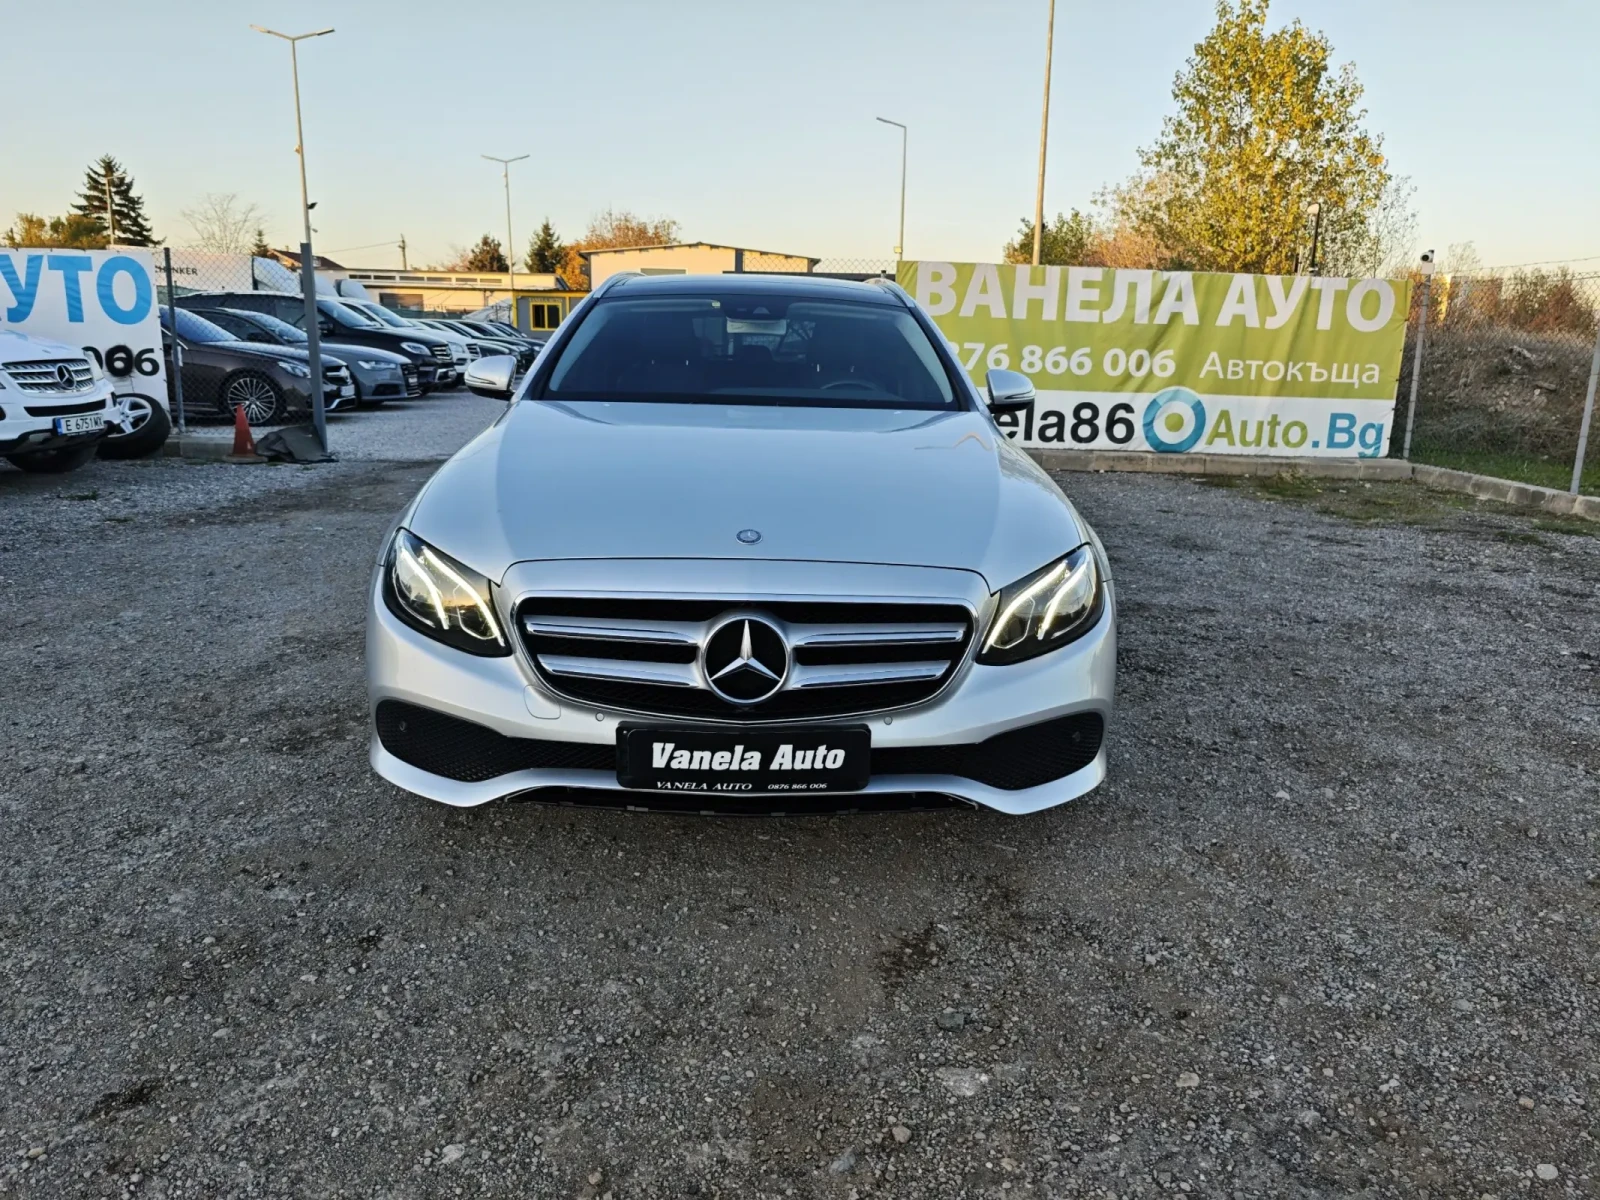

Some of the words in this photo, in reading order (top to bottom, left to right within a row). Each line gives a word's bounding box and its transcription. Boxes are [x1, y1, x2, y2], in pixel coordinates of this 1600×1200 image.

[914, 260, 1200, 326] ВАНЕЛА
[1215, 274, 1396, 333] АУТО
[1020, 344, 1092, 376] 866
[1102, 347, 1176, 378] 006
[1199, 351, 1380, 389] Автокъща
[1205, 409, 1385, 459] Auto.Bg
[651, 742, 762, 771] Vanela
[769, 744, 846, 770] Auto
[656, 781, 708, 790] VANELA
[712, 782, 753, 790] AUTO
